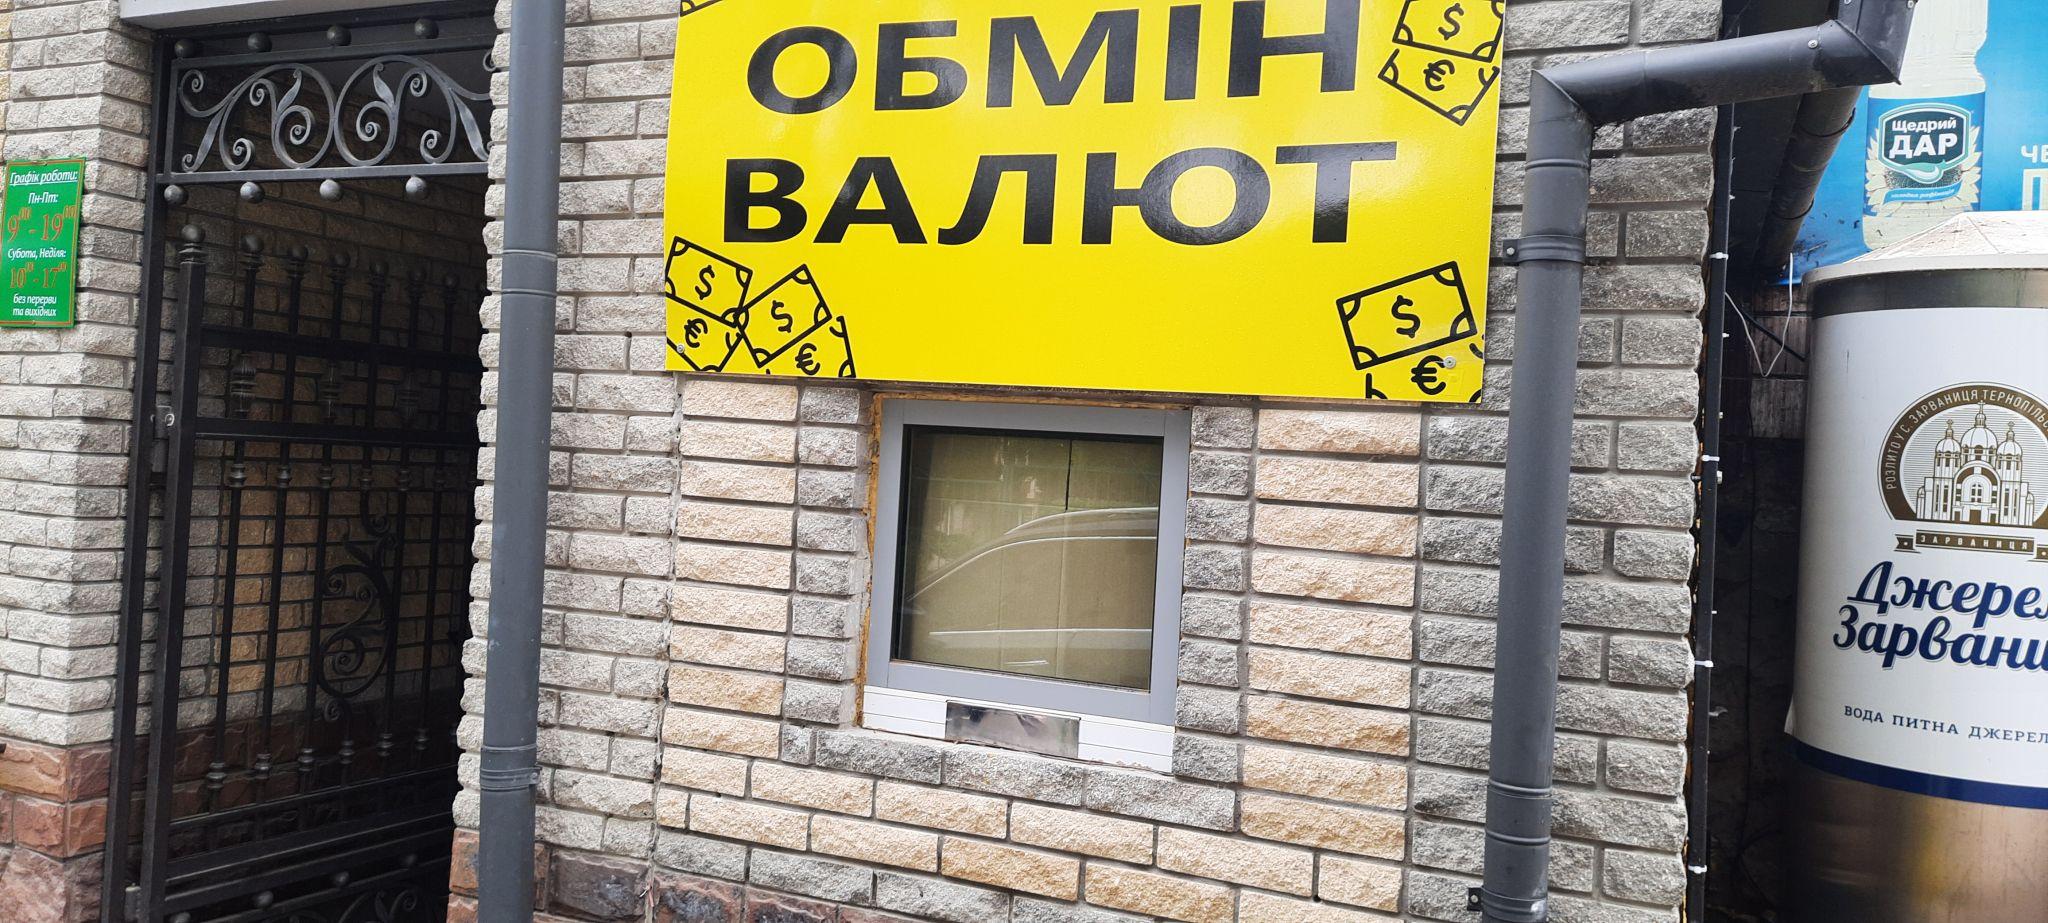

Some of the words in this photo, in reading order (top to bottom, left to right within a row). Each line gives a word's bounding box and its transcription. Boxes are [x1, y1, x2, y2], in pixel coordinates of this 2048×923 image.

[747, 0, 1360, 114] ОБМІН
[1892, 117, 1957, 133] Щедрий
[1889, 133, 1958, 159] ДАР
[10, 171, 40, 187] Графік
[40, 169, 79, 185] роботи:
[28, 191, 59, 204] Пн-Пт:
[723, 141, 1397, 246] ВАЛЮТ
[8, 247, 39, 260] Субота,
[40, 247, 67, 258] Неділя:
[13, 293, 26, 304] без
[27, 296, 57, 306] перерви
[13, 308, 24, 316] та
[25, 306, 57, 316] вихідних
[1885, 441, 1902, 490] РОЗЛИТО
[1909, 389, 1978, 424] ЗАРВАНИЦЯ
[1921, 535, 2028, 550] ЗАРВАНИЦЯ
[1844, 705, 1884, 724] ВОДА
[1892, 714, 1959, 735] ПИТНА
[1968, 726, 2048, 743] ДЖЕРЕЛ
